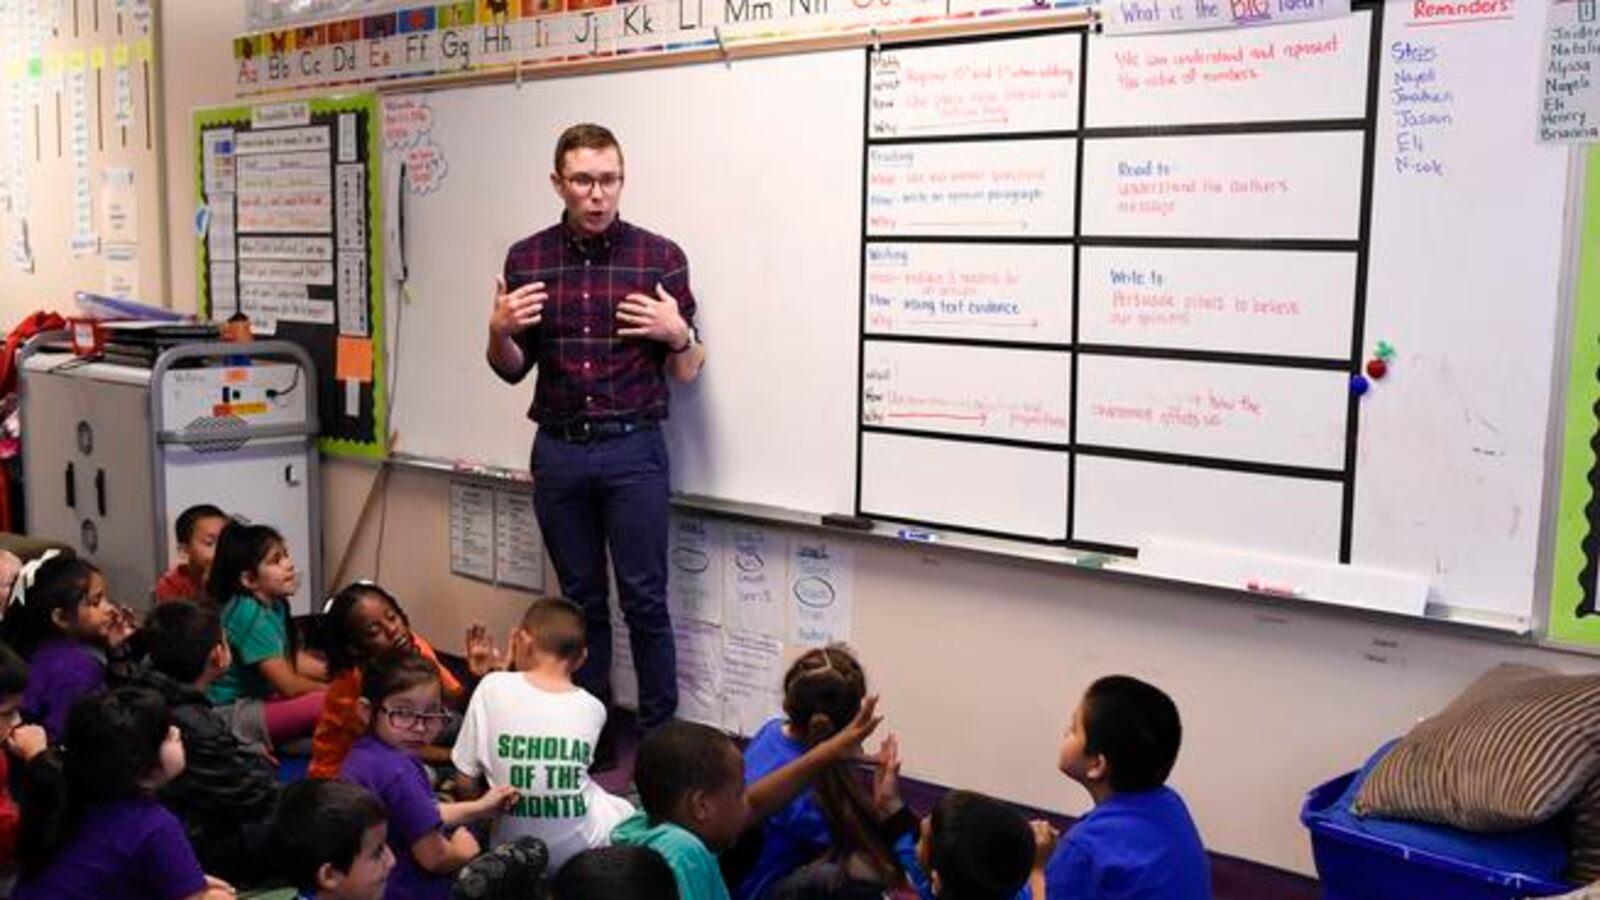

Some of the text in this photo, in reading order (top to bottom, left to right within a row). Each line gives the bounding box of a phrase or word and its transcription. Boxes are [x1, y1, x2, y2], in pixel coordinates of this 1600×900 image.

[1122, 2, 1160, 22] What
[268, 56, 289, 79] Bb
[301, 51, 321, 75] Cc
[333, 46, 356, 72] Dd
[369, 41, 390, 67] Ee
[406, 35, 429, 62] Ff
[441, 31, 469, 69] Gg
[484, 25, 511, 52] Hh
[535, 20, 548, 47] Ii
[574, 12, 598, 55] Jj
[623, 6, 653, 36] Kk
[679, 0, 703, 30] Ll
[725, 0, 772, 23] Mm
[498, 734, 591, 765] SCHOLAR
[510, 764, 582, 790] OF THE
